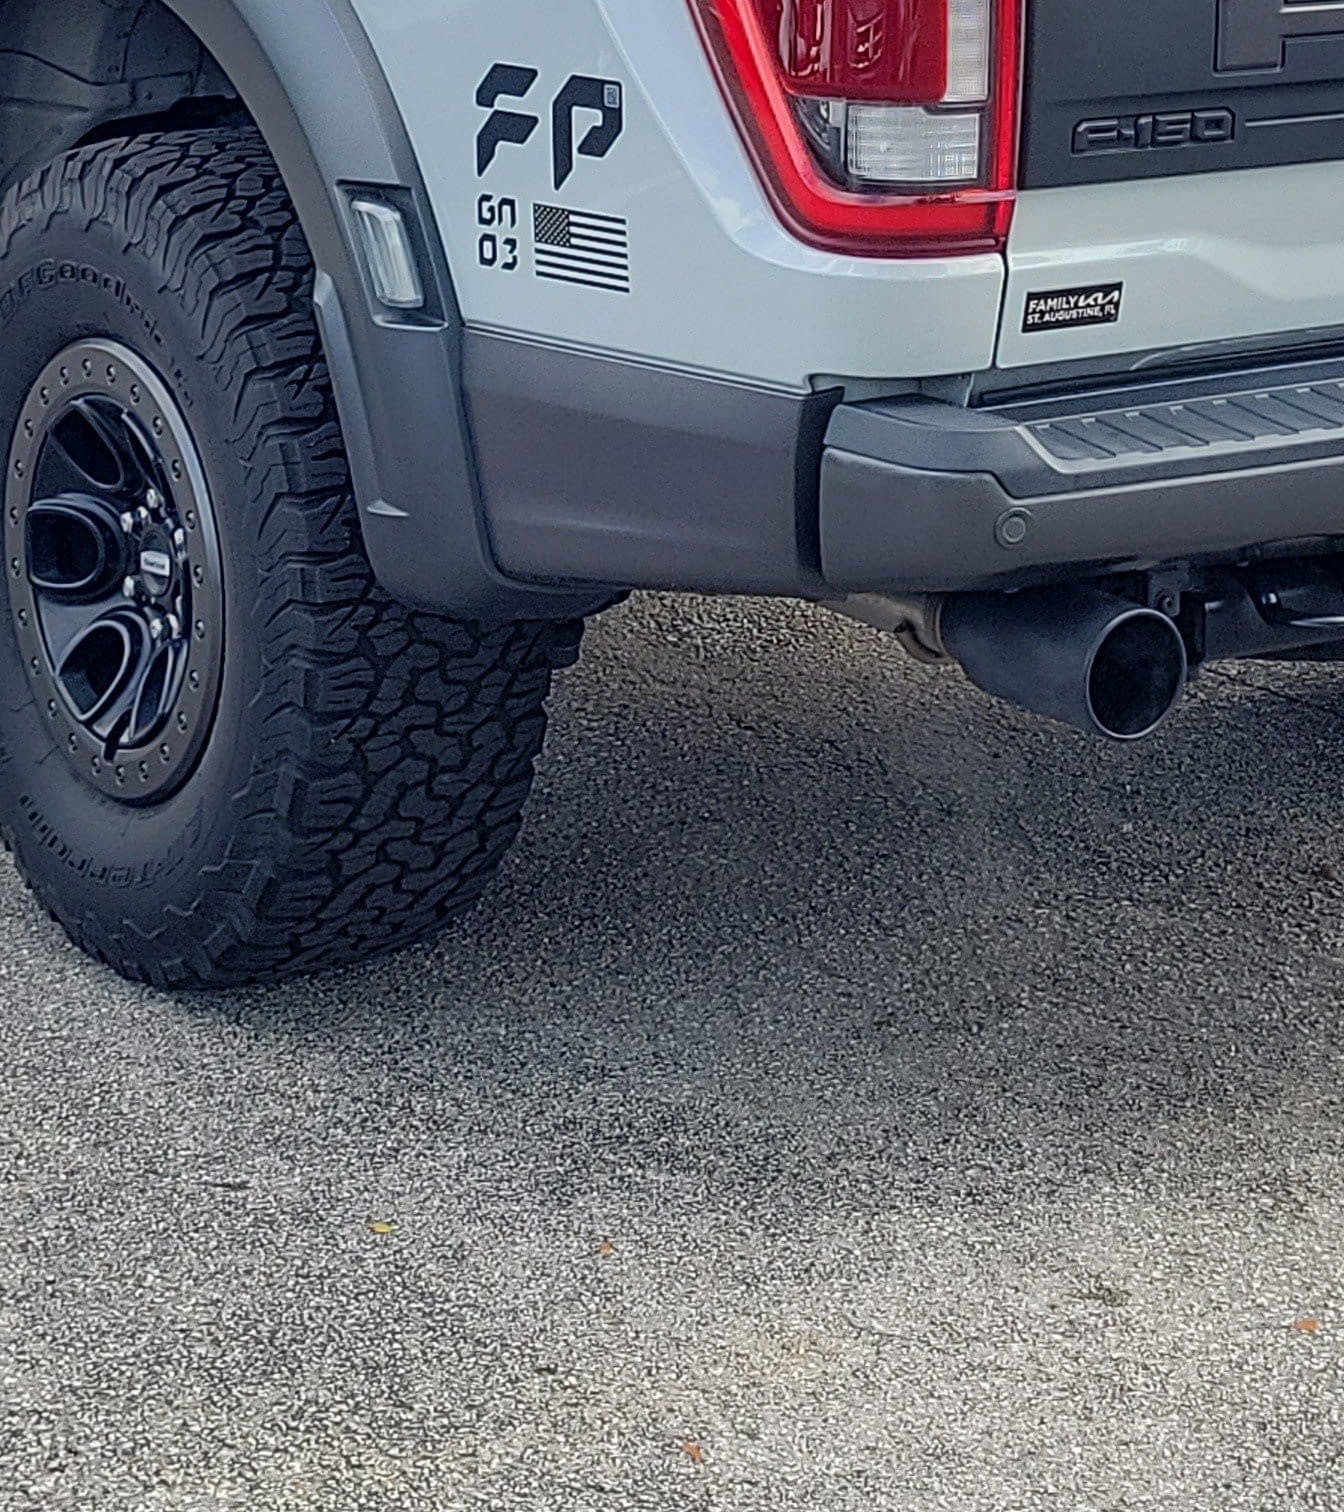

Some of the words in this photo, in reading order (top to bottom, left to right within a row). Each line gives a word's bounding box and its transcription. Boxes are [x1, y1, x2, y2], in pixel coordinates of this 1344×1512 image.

[474, 62, 623, 192] FP
[1071, 106, 1235, 156] F-150
[478, 232, 518, 271] 03
[1026, 314, 1042, 325] ST.
[1043, 306, 1102, 322] AUGUSTINE,
[1028, 295, 1078, 313] FAMILY
